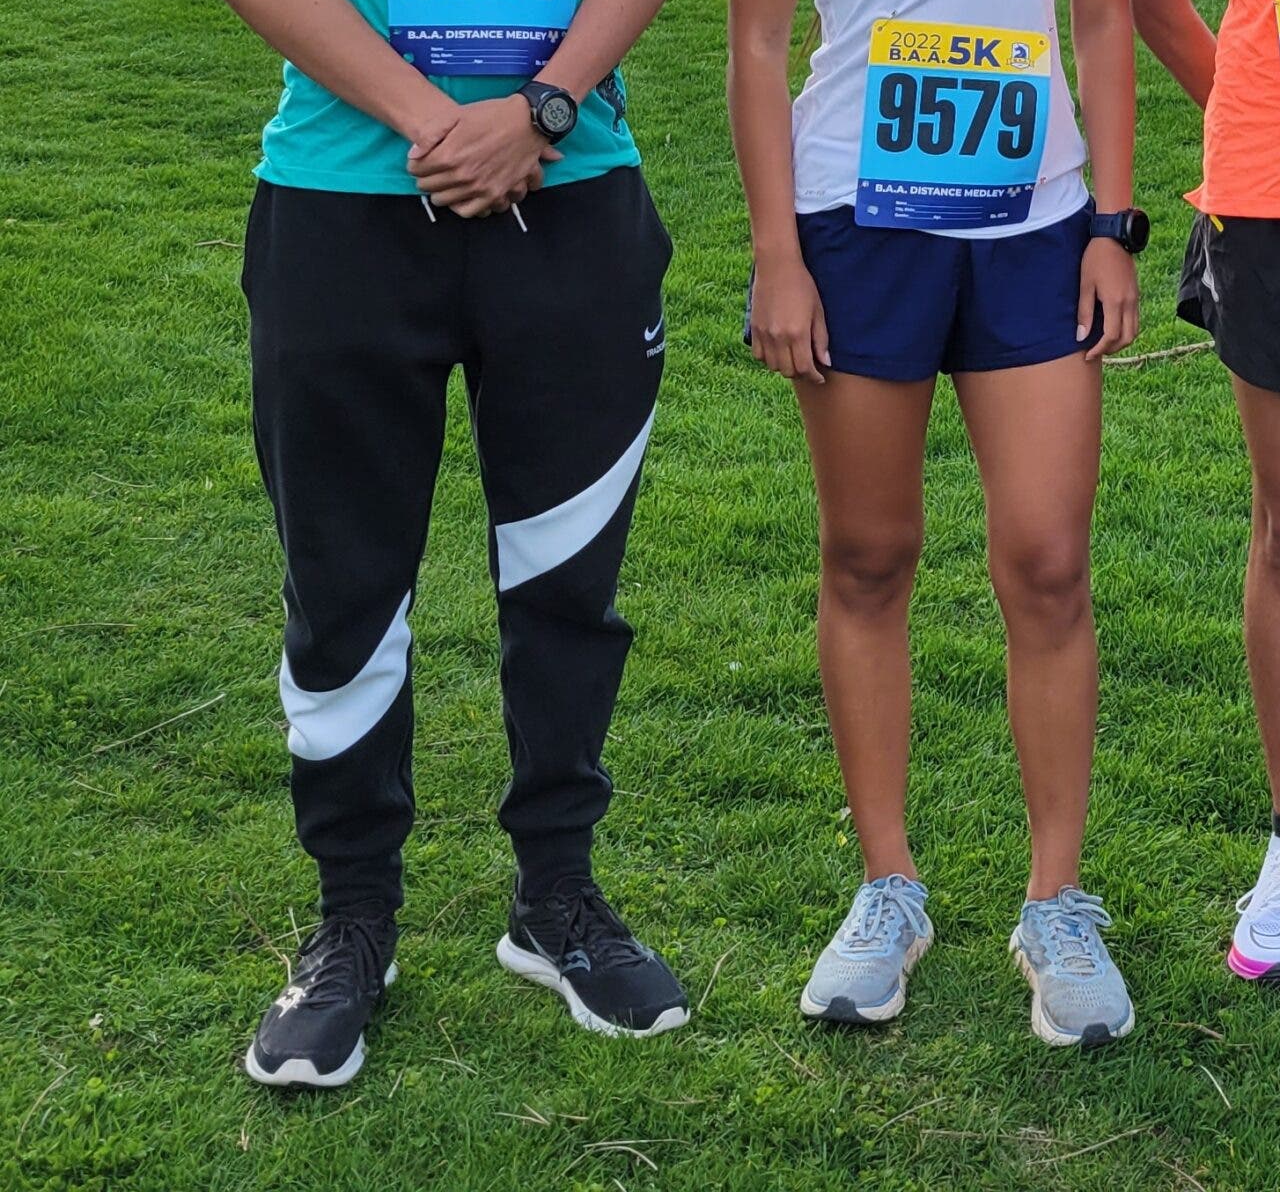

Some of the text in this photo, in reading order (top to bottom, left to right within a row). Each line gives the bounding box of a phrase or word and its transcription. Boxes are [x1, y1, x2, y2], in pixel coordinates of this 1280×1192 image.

[407, 30, 547, 41] B.A.A. DISTANCE MEDLEY
[890, 31, 941, 50] 2022
[889, 36, 1001, 68] B.A.A. 5K
[876, 72, 1037, 159] 9579
[875, 184, 1005, 198] B.A.A. DISTANCE MEDLEY
